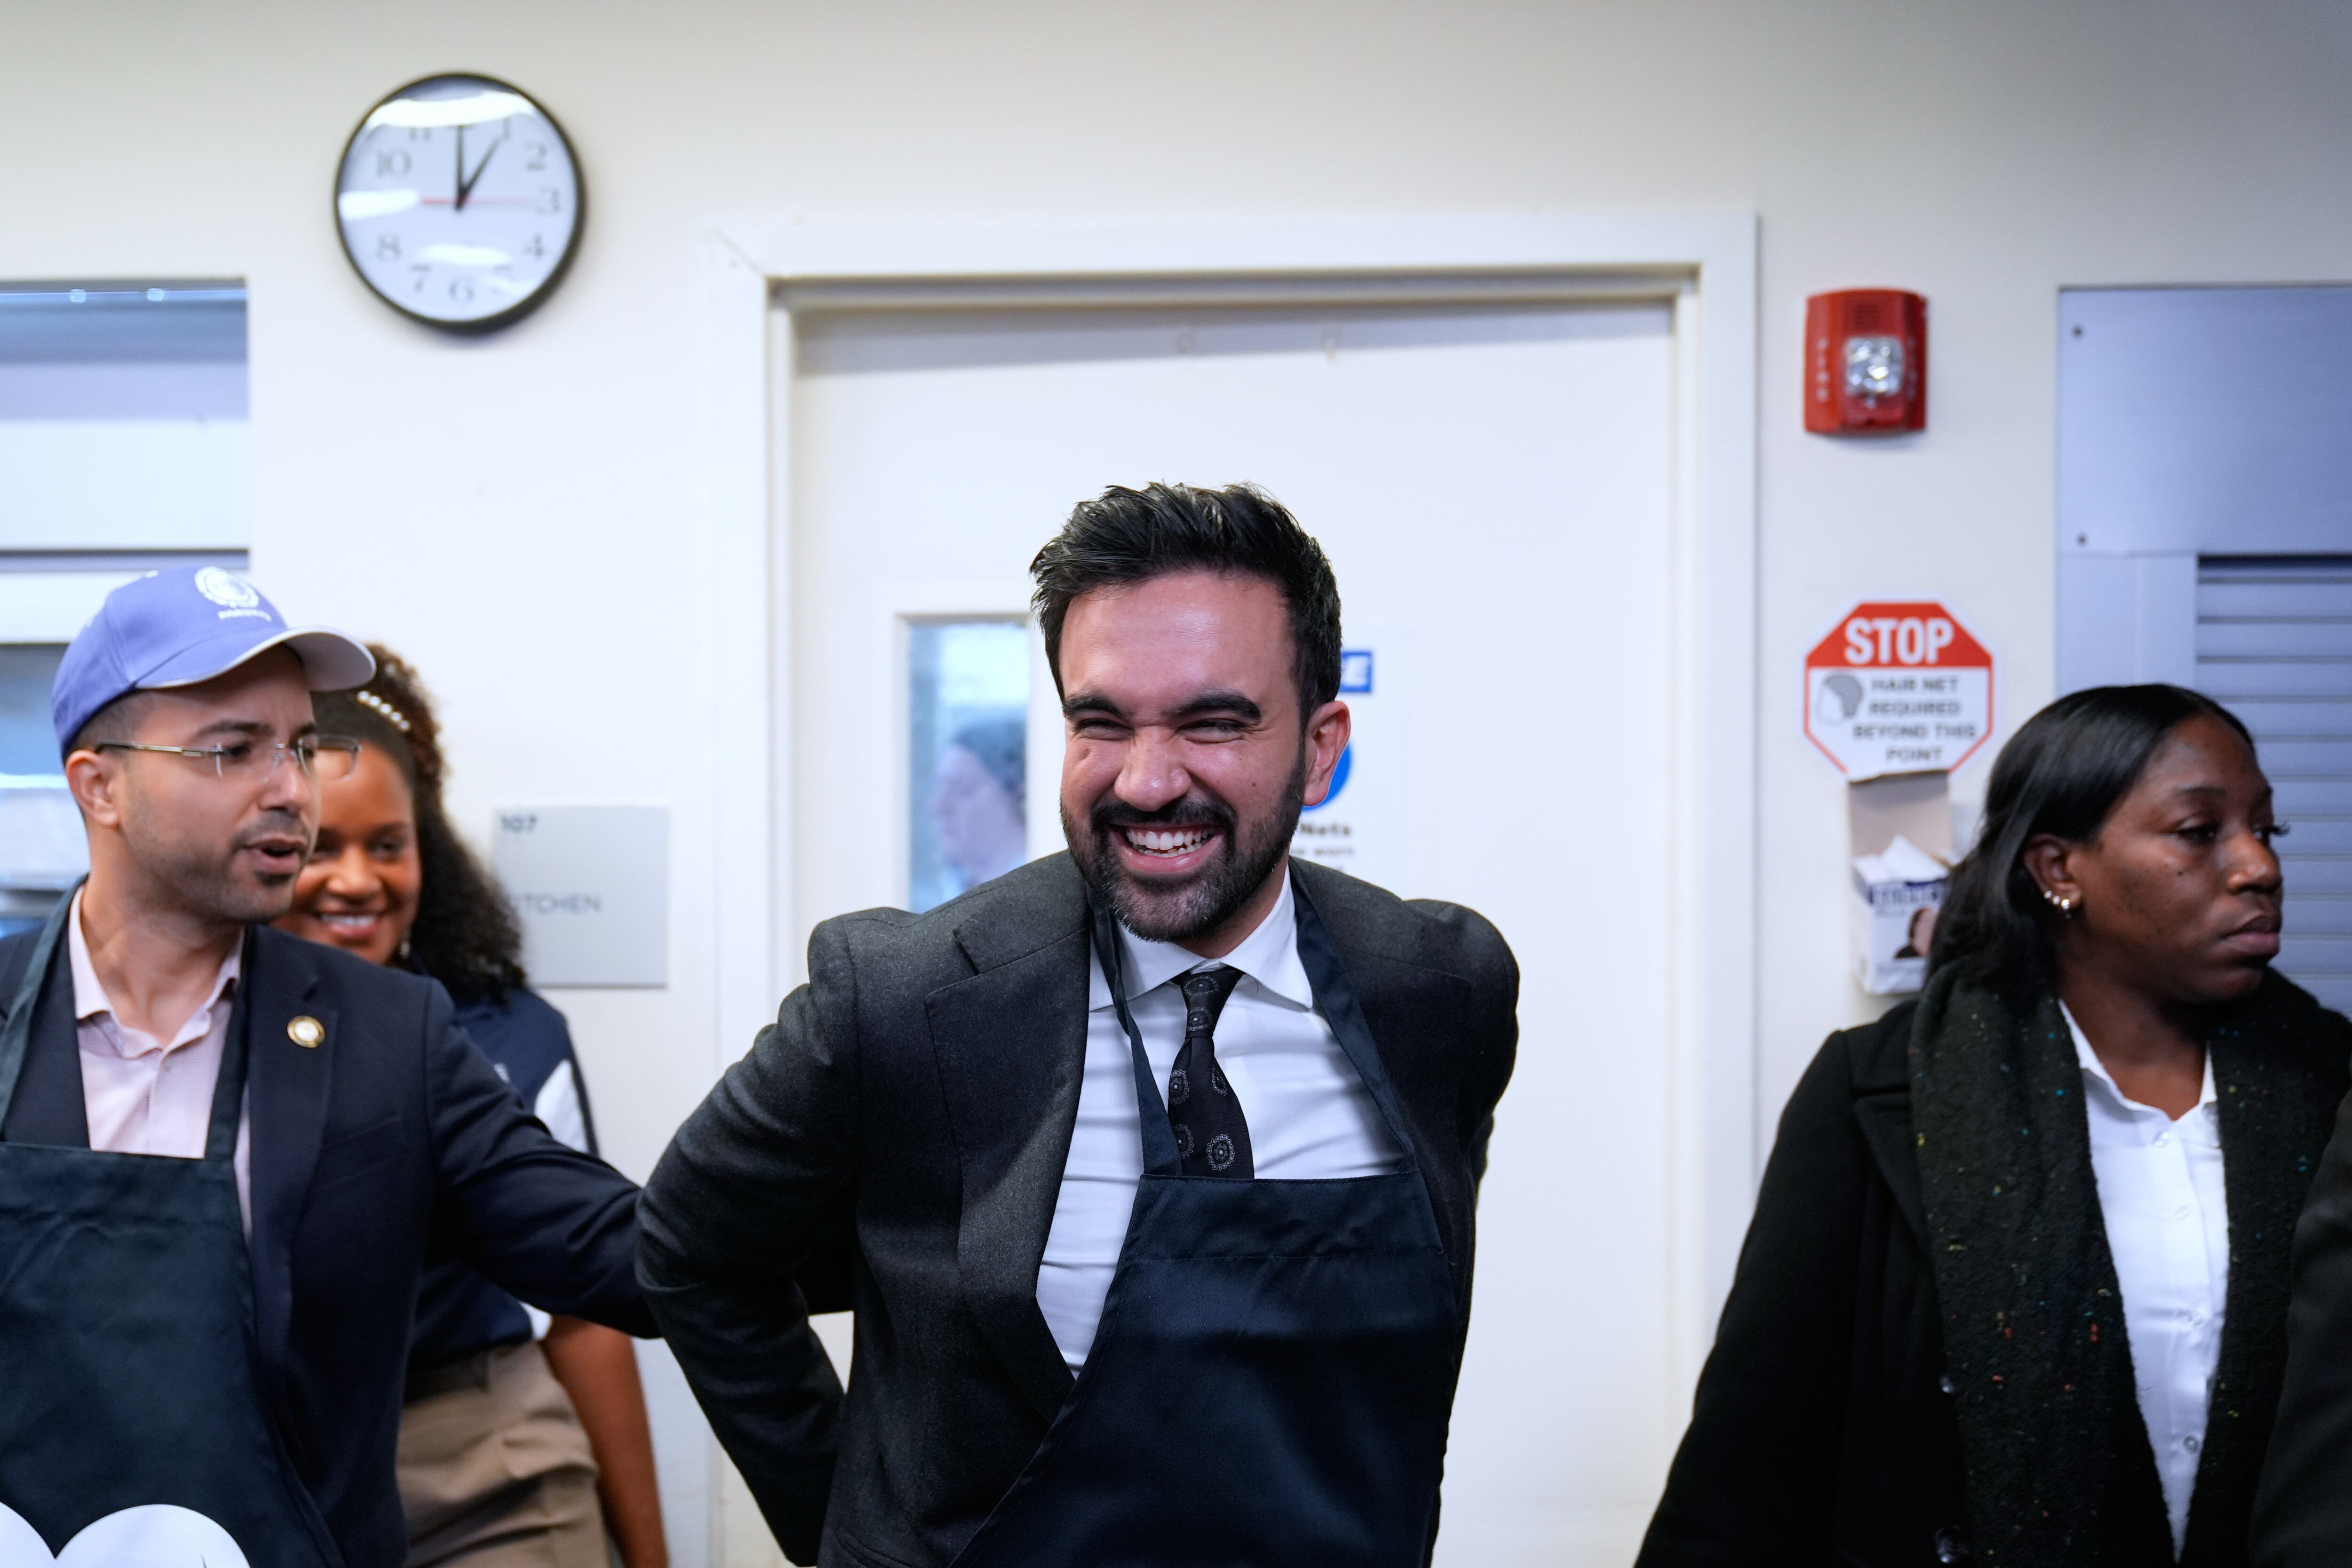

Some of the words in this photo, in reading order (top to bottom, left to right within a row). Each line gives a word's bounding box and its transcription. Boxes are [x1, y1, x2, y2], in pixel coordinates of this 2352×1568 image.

[376, 148, 413, 178] 10
[524, 142, 547, 171] 2
[535, 186, 561, 216] 3
[376, 233, 402, 262] 8
[523, 234, 544, 260] 4
[409, 264, 433, 292] 7
[448, 275, 474, 303] 6
[1844, 617, 1954, 665] STOP
[1872, 677, 1915, 692] HAIR
[1923, 676, 1959, 692] NET
[1869, 700, 1961, 716] REQUIRED
[1853, 724, 1928, 740] BEYOND
[1935, 723, 1975, 738] THIS
[1886, 747, 1942, 762] POINT
[501, 814, 538, 834] 107
[521, 892, 602, 915] TCHEN
